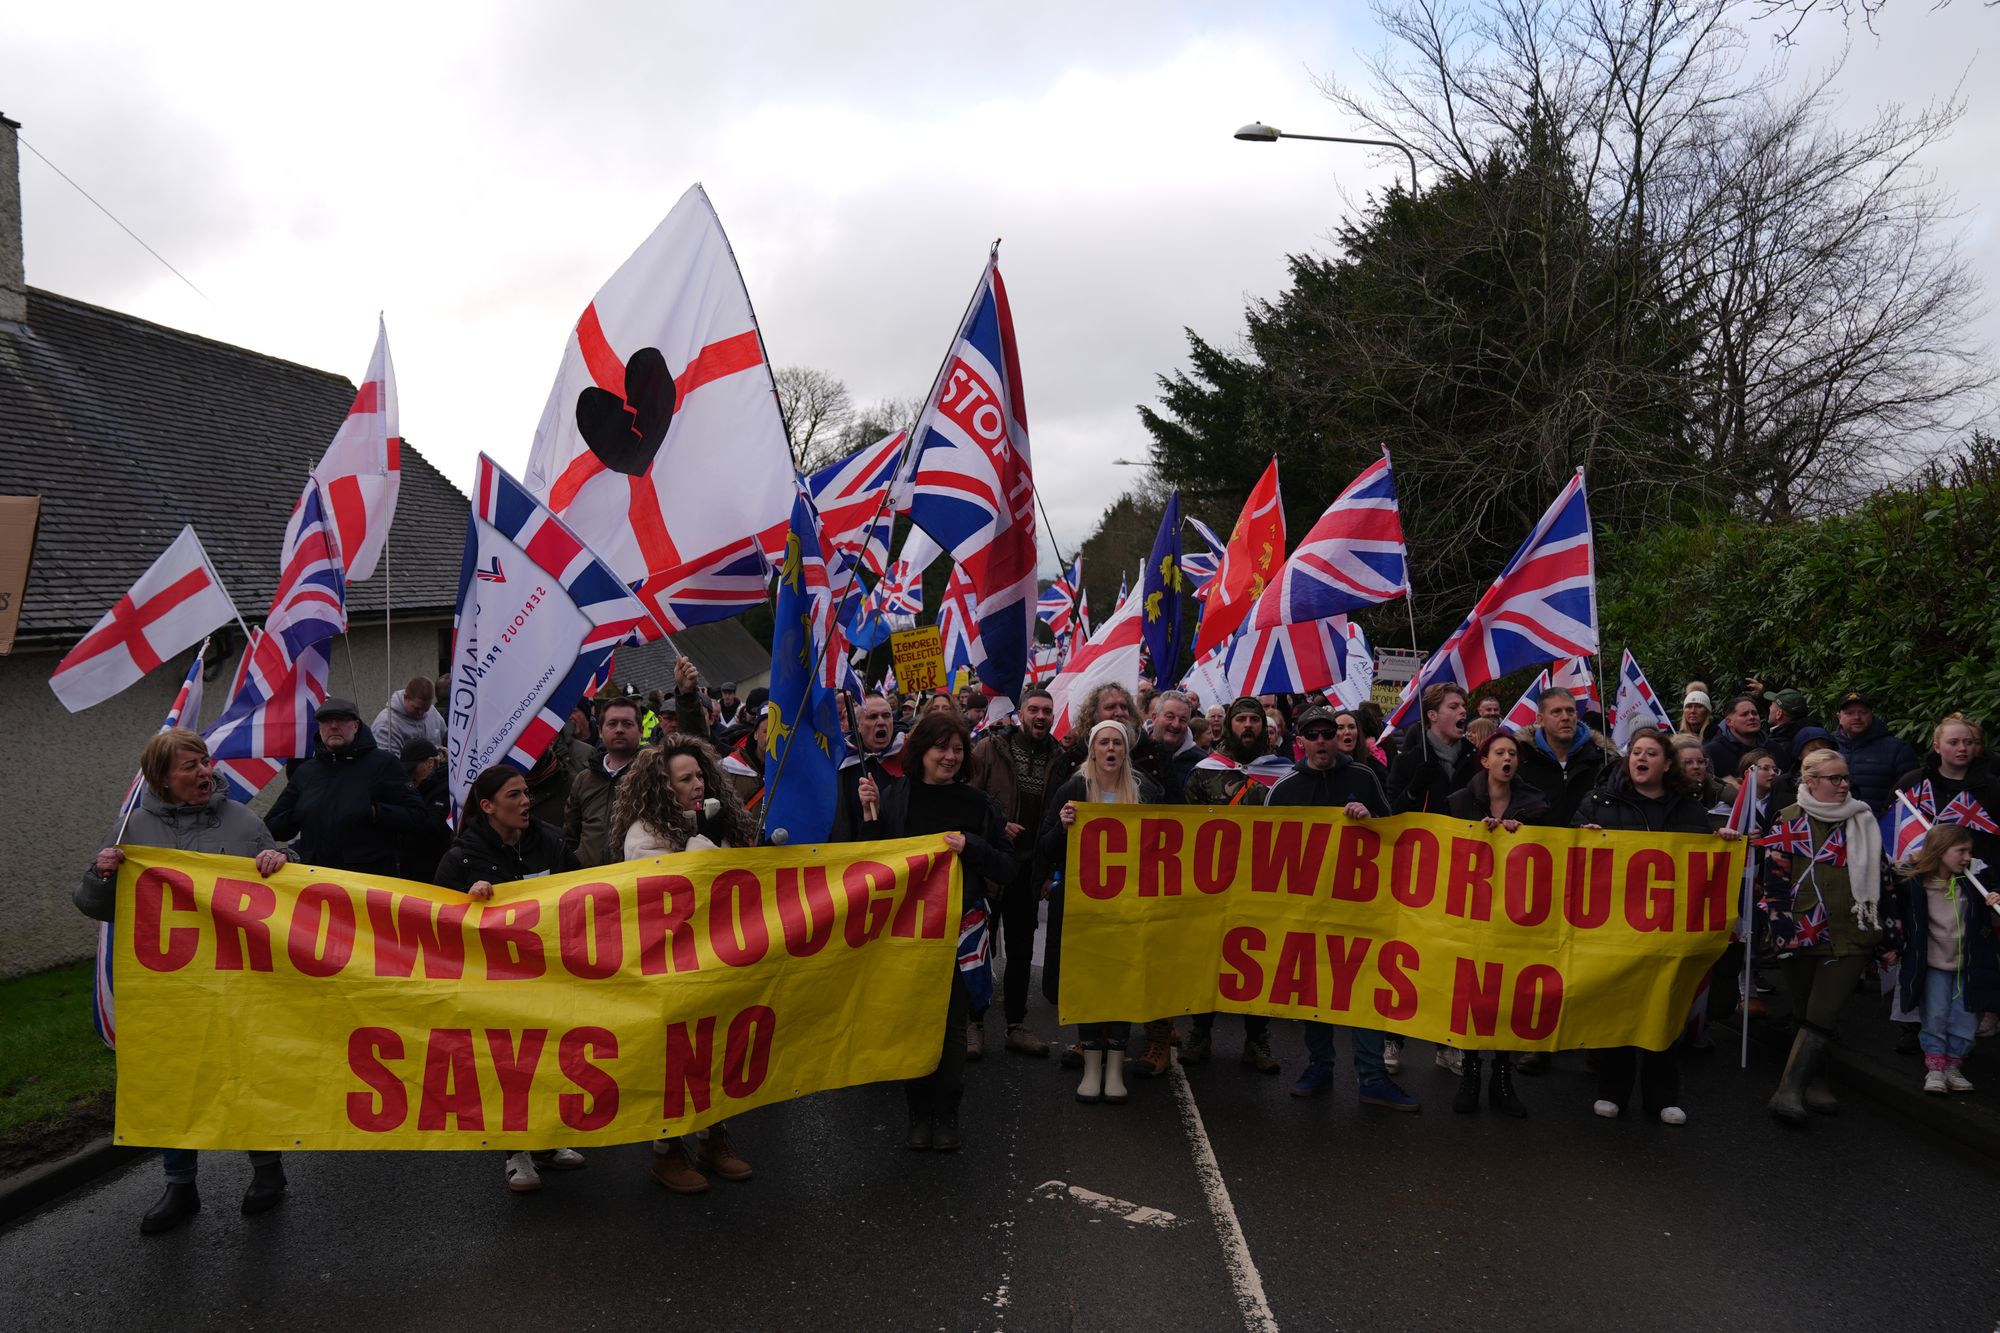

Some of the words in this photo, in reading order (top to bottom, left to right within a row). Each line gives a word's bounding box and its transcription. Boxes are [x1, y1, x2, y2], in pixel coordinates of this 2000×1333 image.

[942, 368, 1011, 463] STOP
[1009, 471, 1036, 535] TH
[894, 638, 939, 653] IGNORED
[894, 647, 942, 664] NEGLECTED
[900, 669, 921, 681] LEFT
[926, 665, 938, 677] AT
[907, 674, 938, 693] RISK
[134, 850, 956, 981] CROWBOROUGH
[1080, 817, 1731, 932] CROWBOROUGH
[1219, 927, 1420, 1021] SAYS
[1450, 957, 1564, 1041] NO
[347, 1026, 620, 1133] SAYS
[664, 1005, 776, 1119] NO
